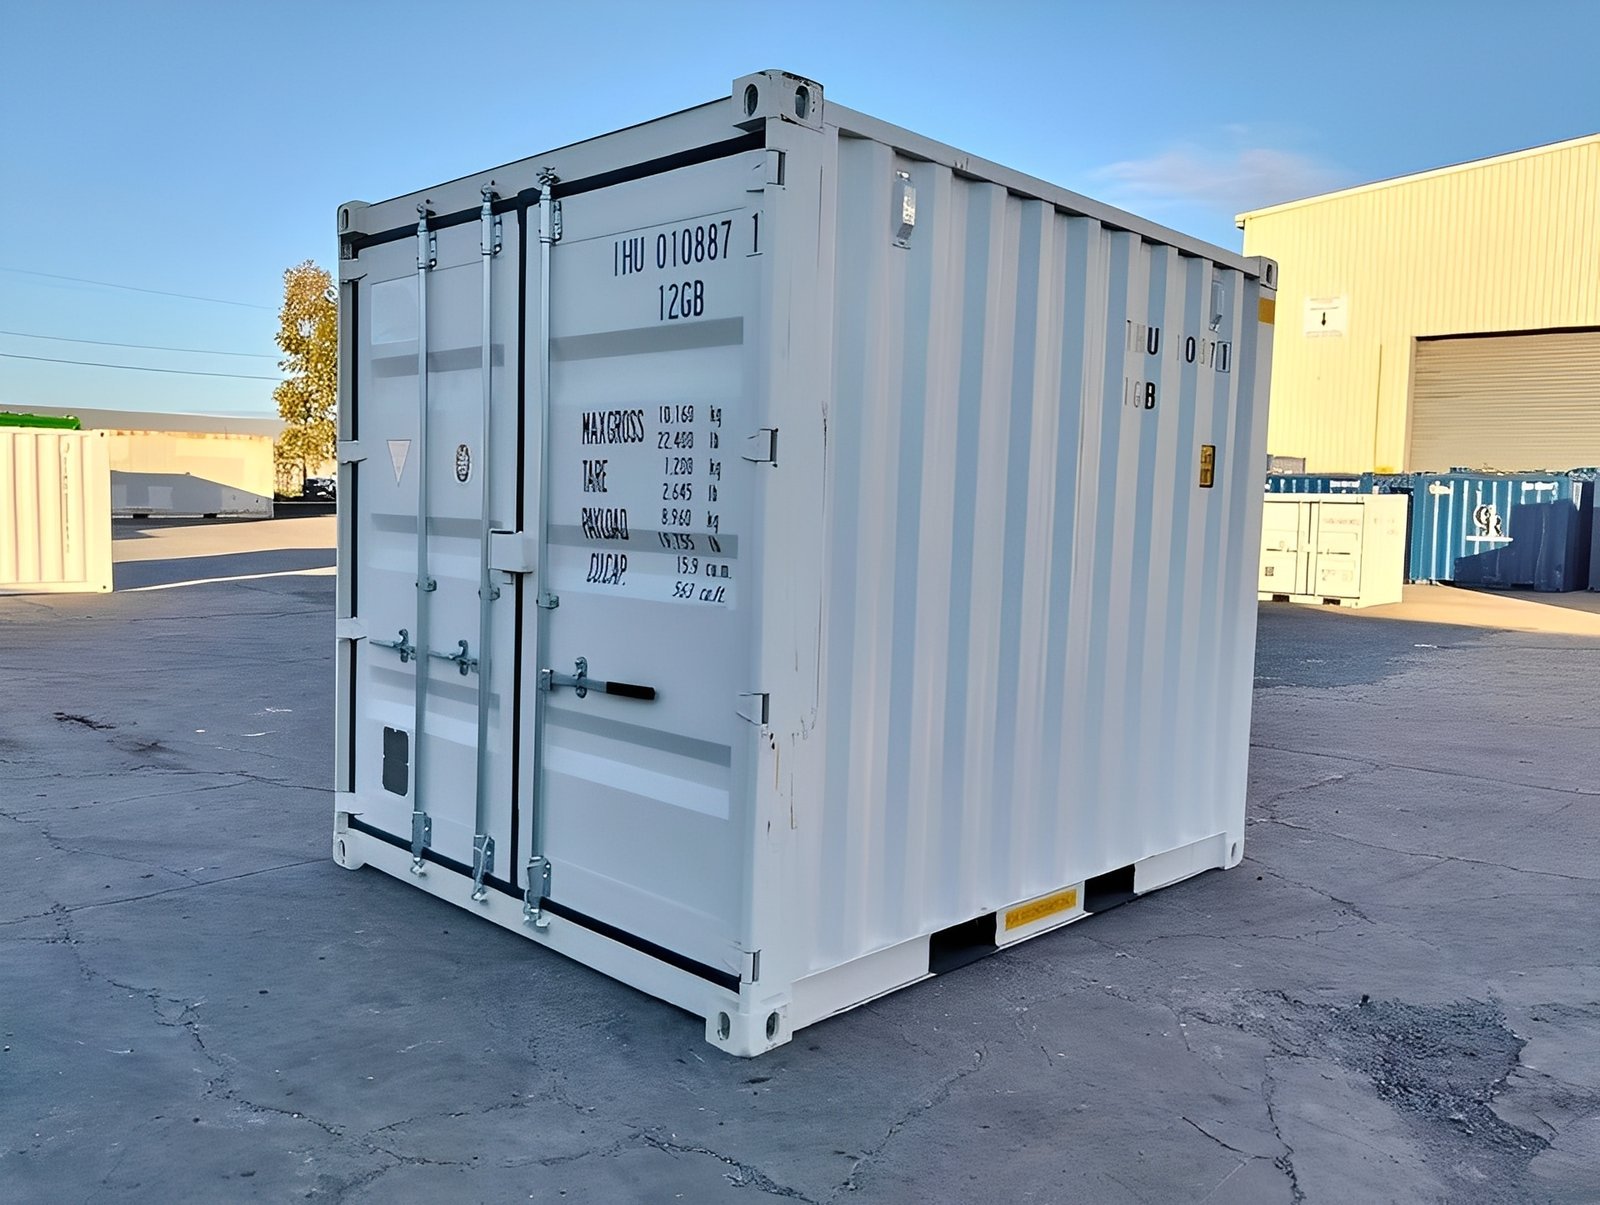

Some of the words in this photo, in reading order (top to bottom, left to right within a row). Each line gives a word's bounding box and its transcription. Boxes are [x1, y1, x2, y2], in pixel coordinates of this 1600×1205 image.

[656, 219, 732, 269] 010887
[751, 212, 759, 253] 1
[658, 279, 704, 321] 12GB
[710, 405, 722, 428] kg
[582, 459, 608, 492] TARE
[709, 458, 721, 481] kg
[582, 507, 629, 540] PAYLOAD
[706, 510, 719, 534] kg
